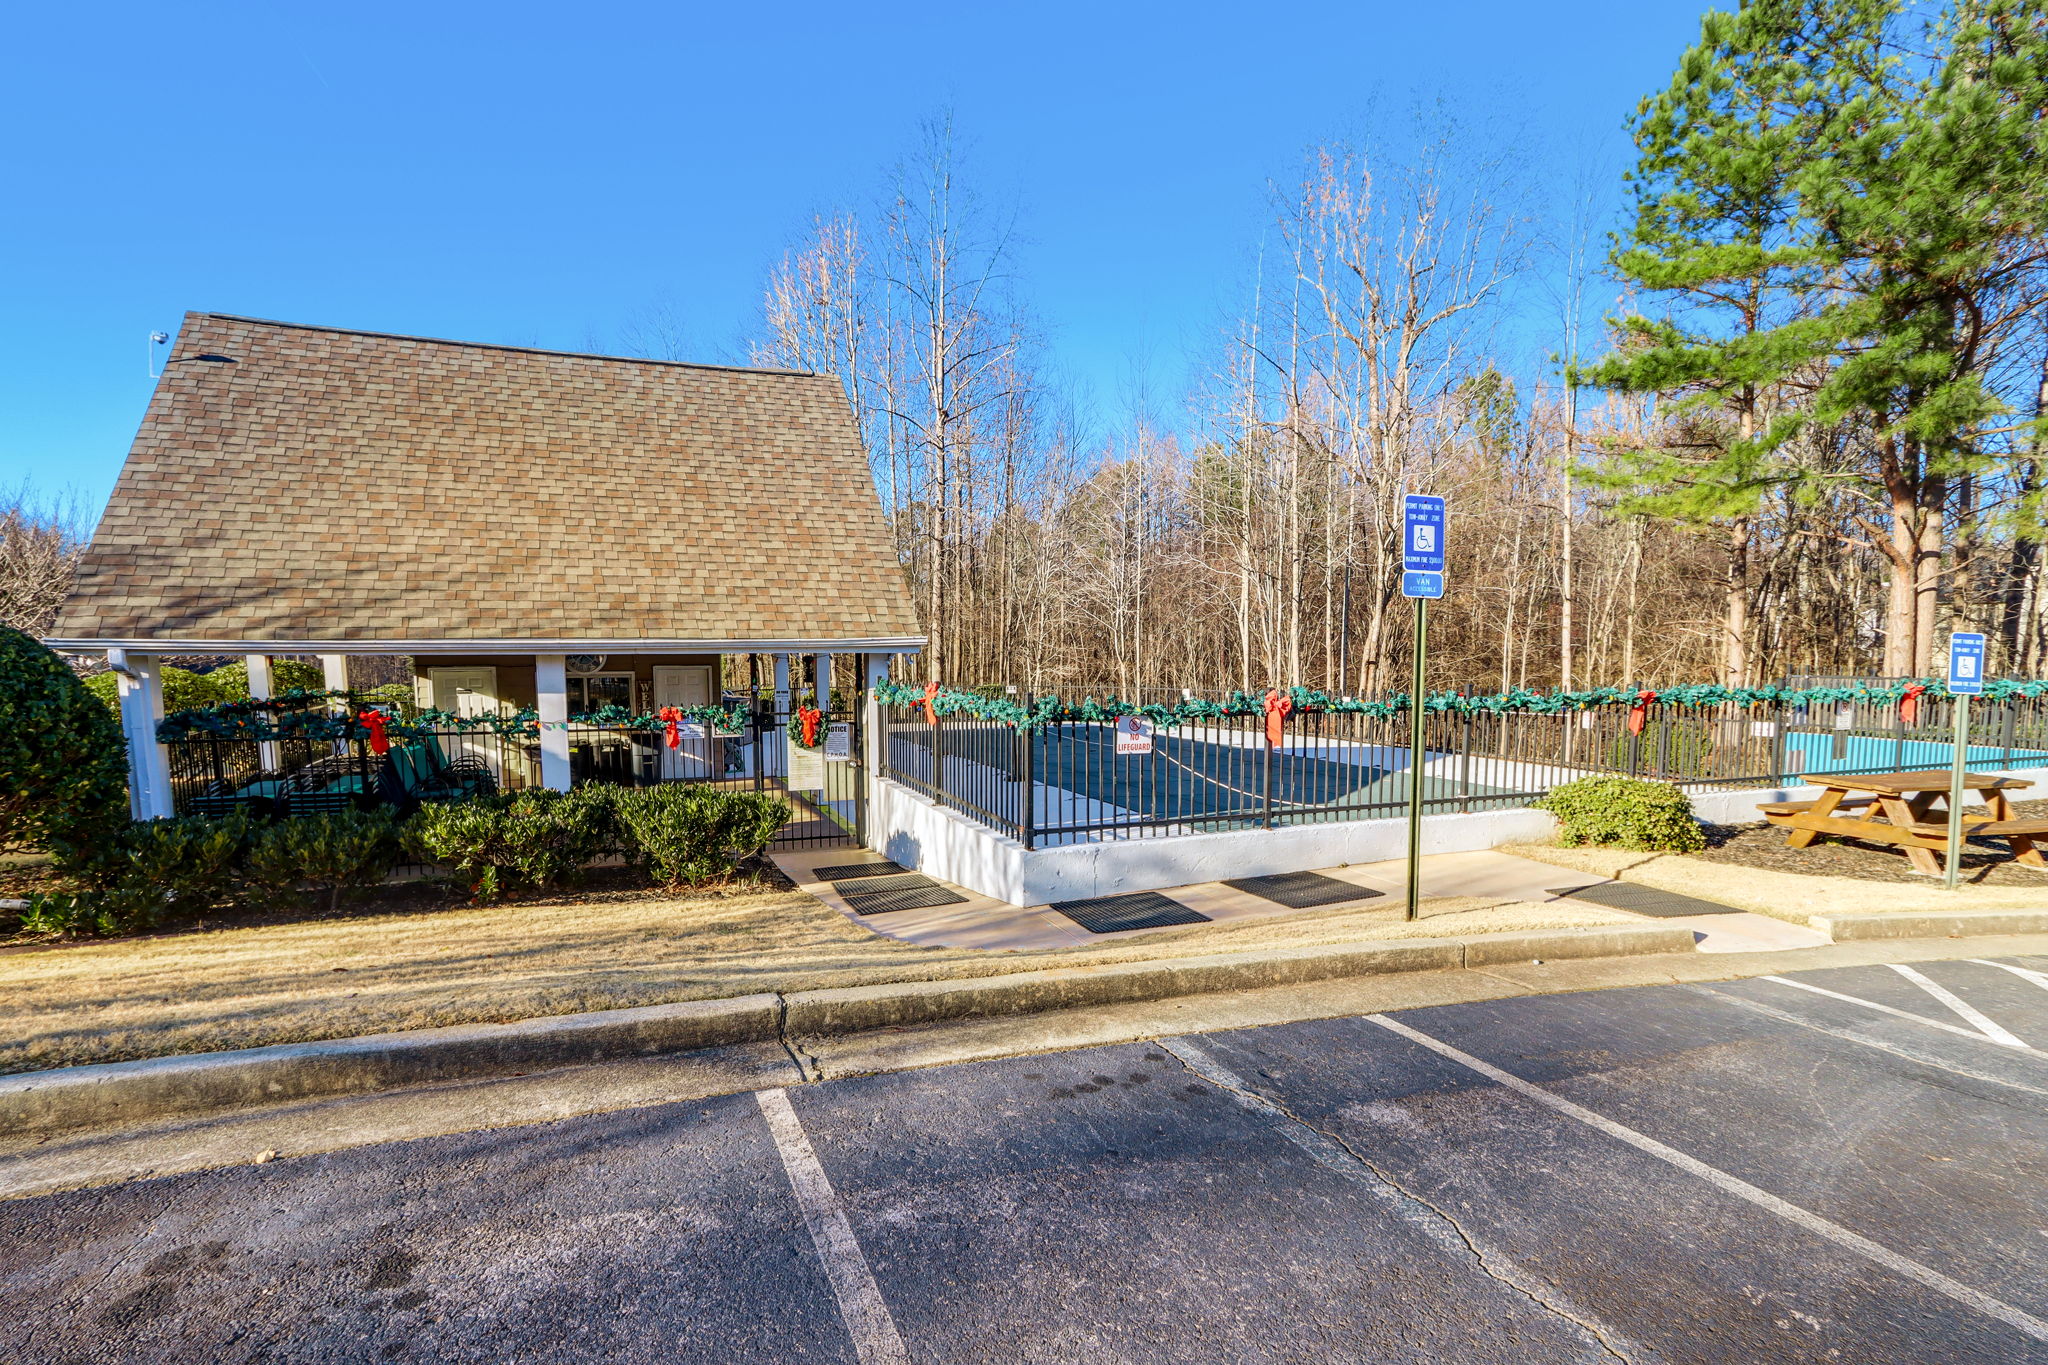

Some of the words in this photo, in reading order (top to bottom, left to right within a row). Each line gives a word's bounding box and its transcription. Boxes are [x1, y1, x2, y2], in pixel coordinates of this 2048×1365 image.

[1416, 577, 1430, 586] VAN
[1129, 733, 1140, 741] NO
[1118, 743, 1151, 751] LIFEGUARD
